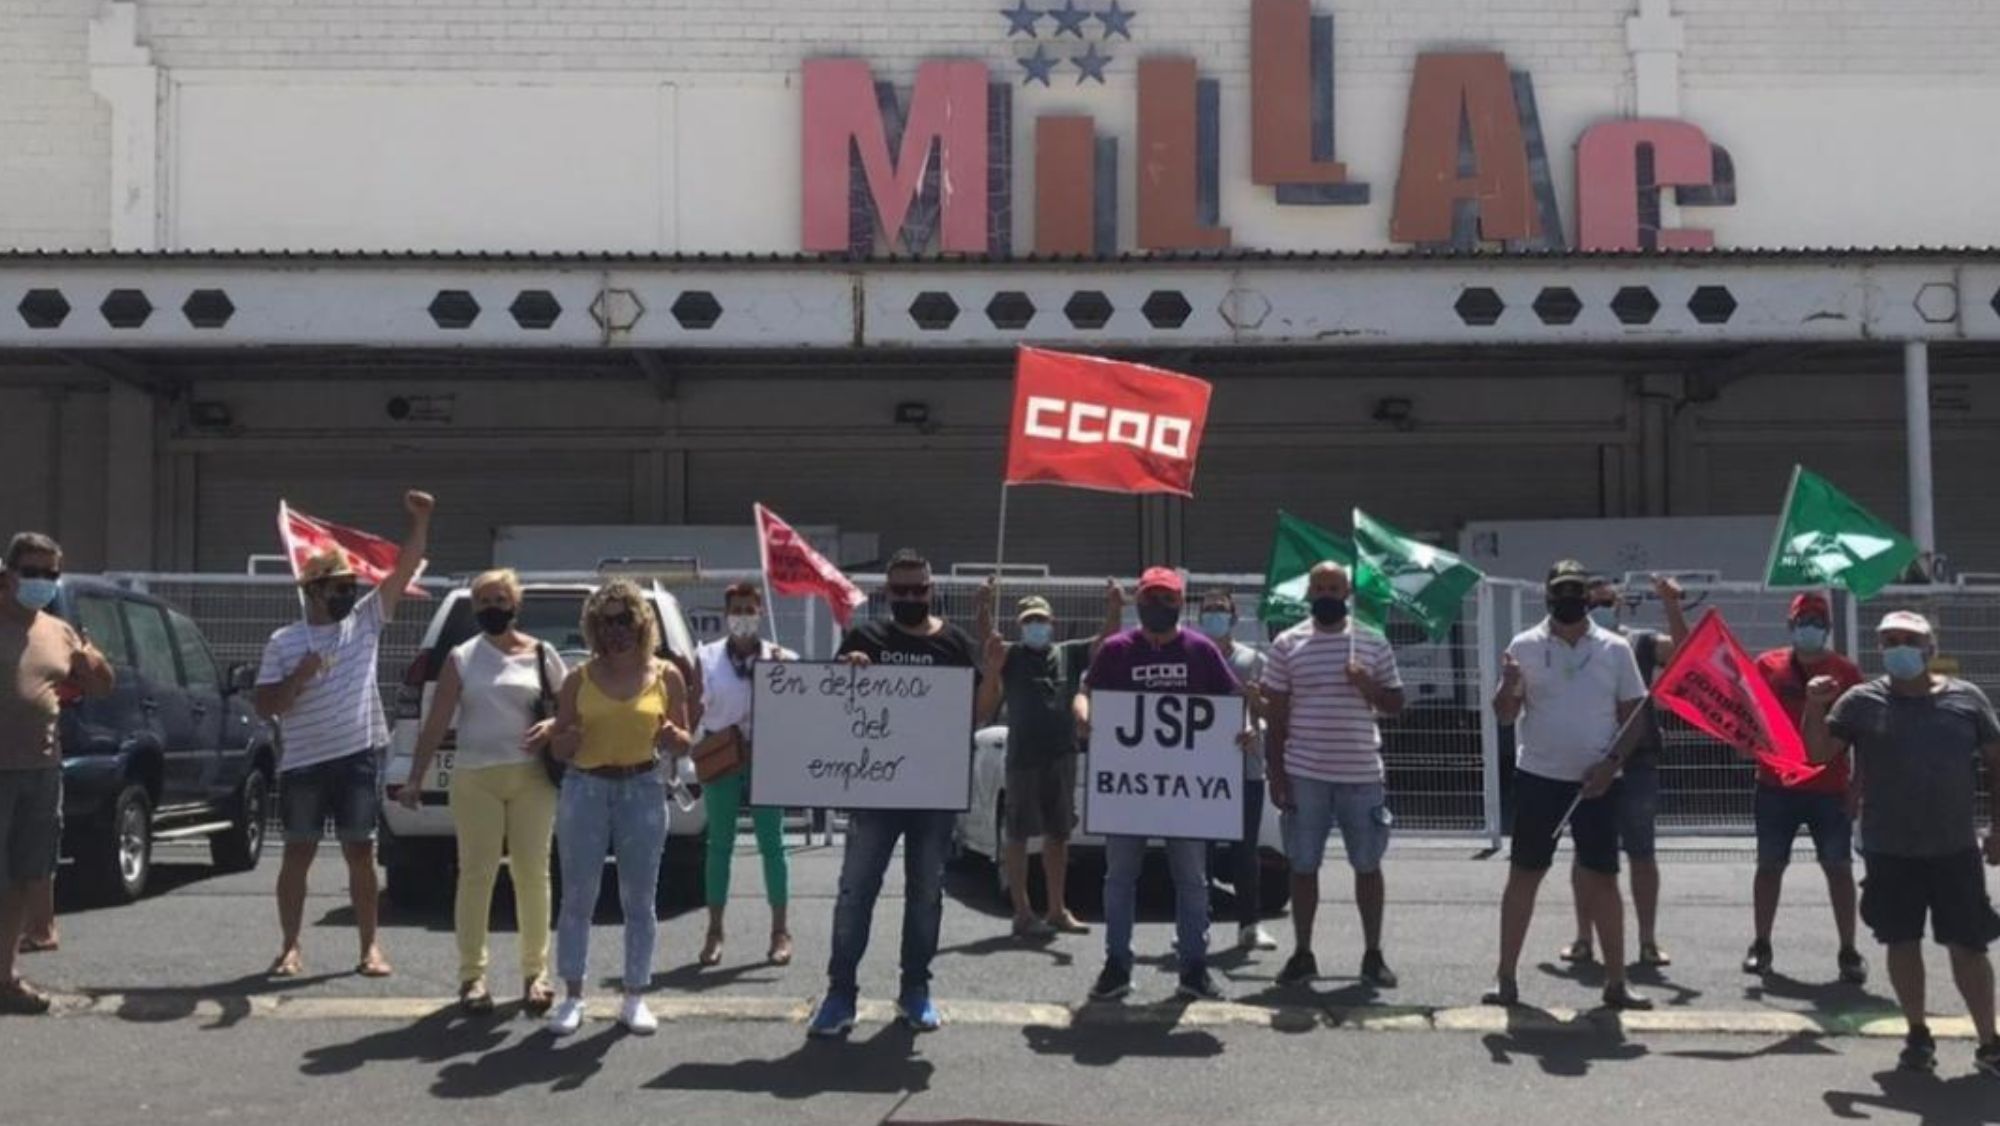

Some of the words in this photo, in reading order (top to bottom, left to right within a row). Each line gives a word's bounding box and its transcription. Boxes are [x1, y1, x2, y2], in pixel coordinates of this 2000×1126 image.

[1024, 396, 1192, 459] CCOO
[767, 665, 806, 695] En
[818, 666, 932, 716] defensa
[1132, 663, 1188, 681] CCOO
[851, 706, 891, 739] del
[1115, 694, 1216, 750] JSP
[1097, 771, 1190, 798] BASTA
[1196, 776, 1232, 800] YA
